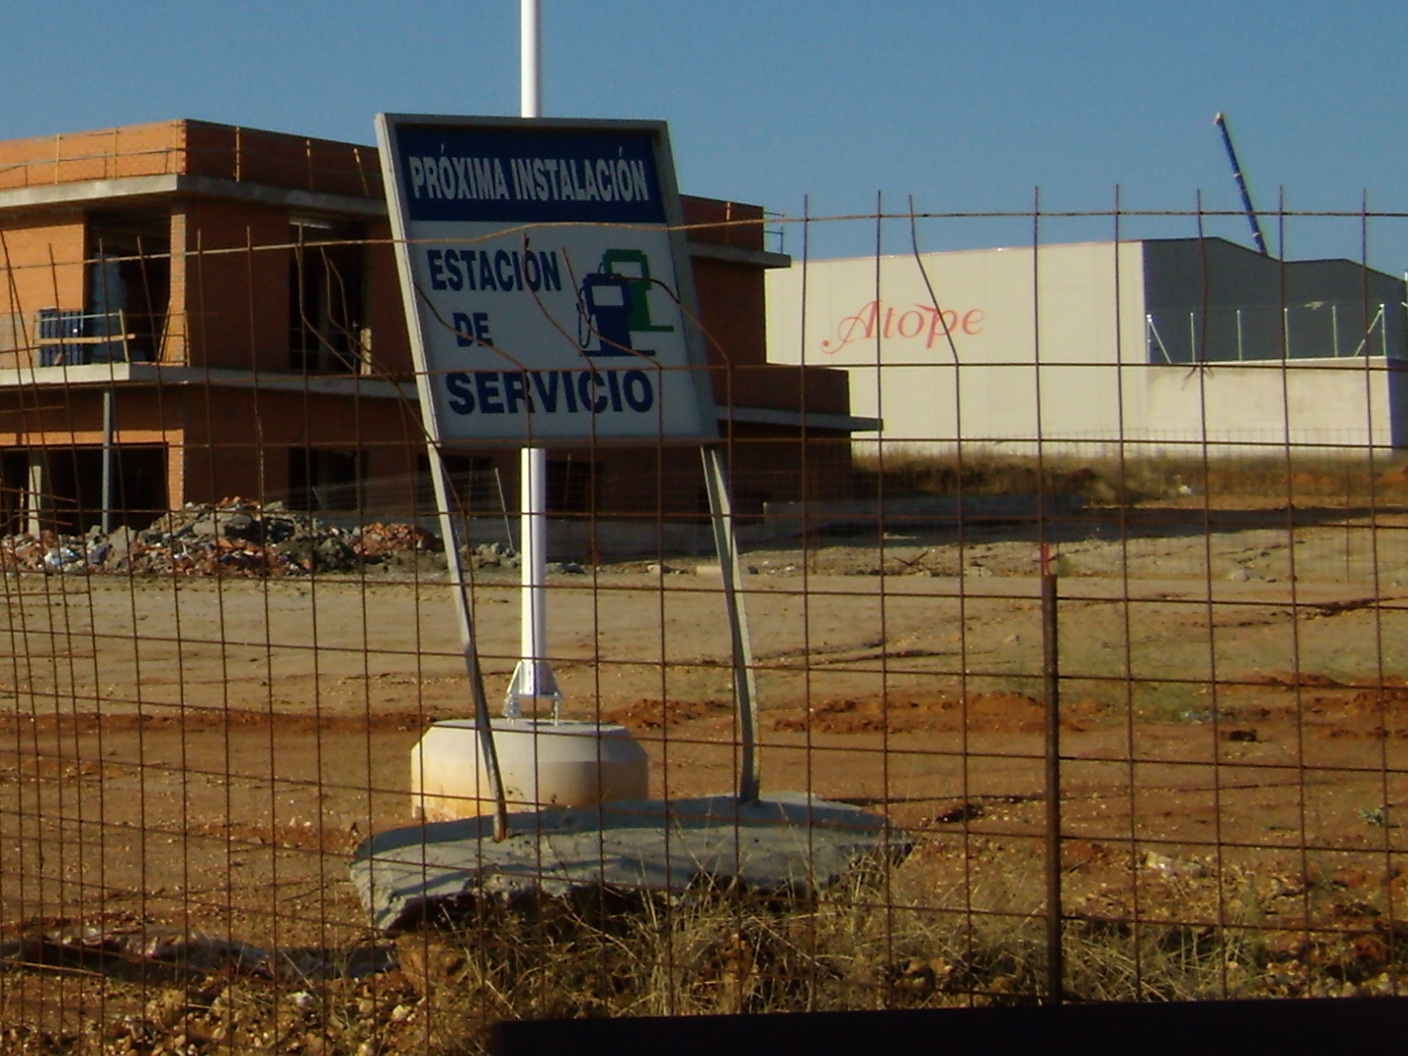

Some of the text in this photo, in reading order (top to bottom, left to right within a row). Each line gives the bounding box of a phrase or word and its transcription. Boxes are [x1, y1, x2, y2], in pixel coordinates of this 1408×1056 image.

[409, 143, 649, 202] PRÓXIMA INSTALACIÓN
[426, 237, 562, 292] ESTACIÓN
[453, 312, 493, 348] DE
[446, 370, 654, 416] SERVICIO
